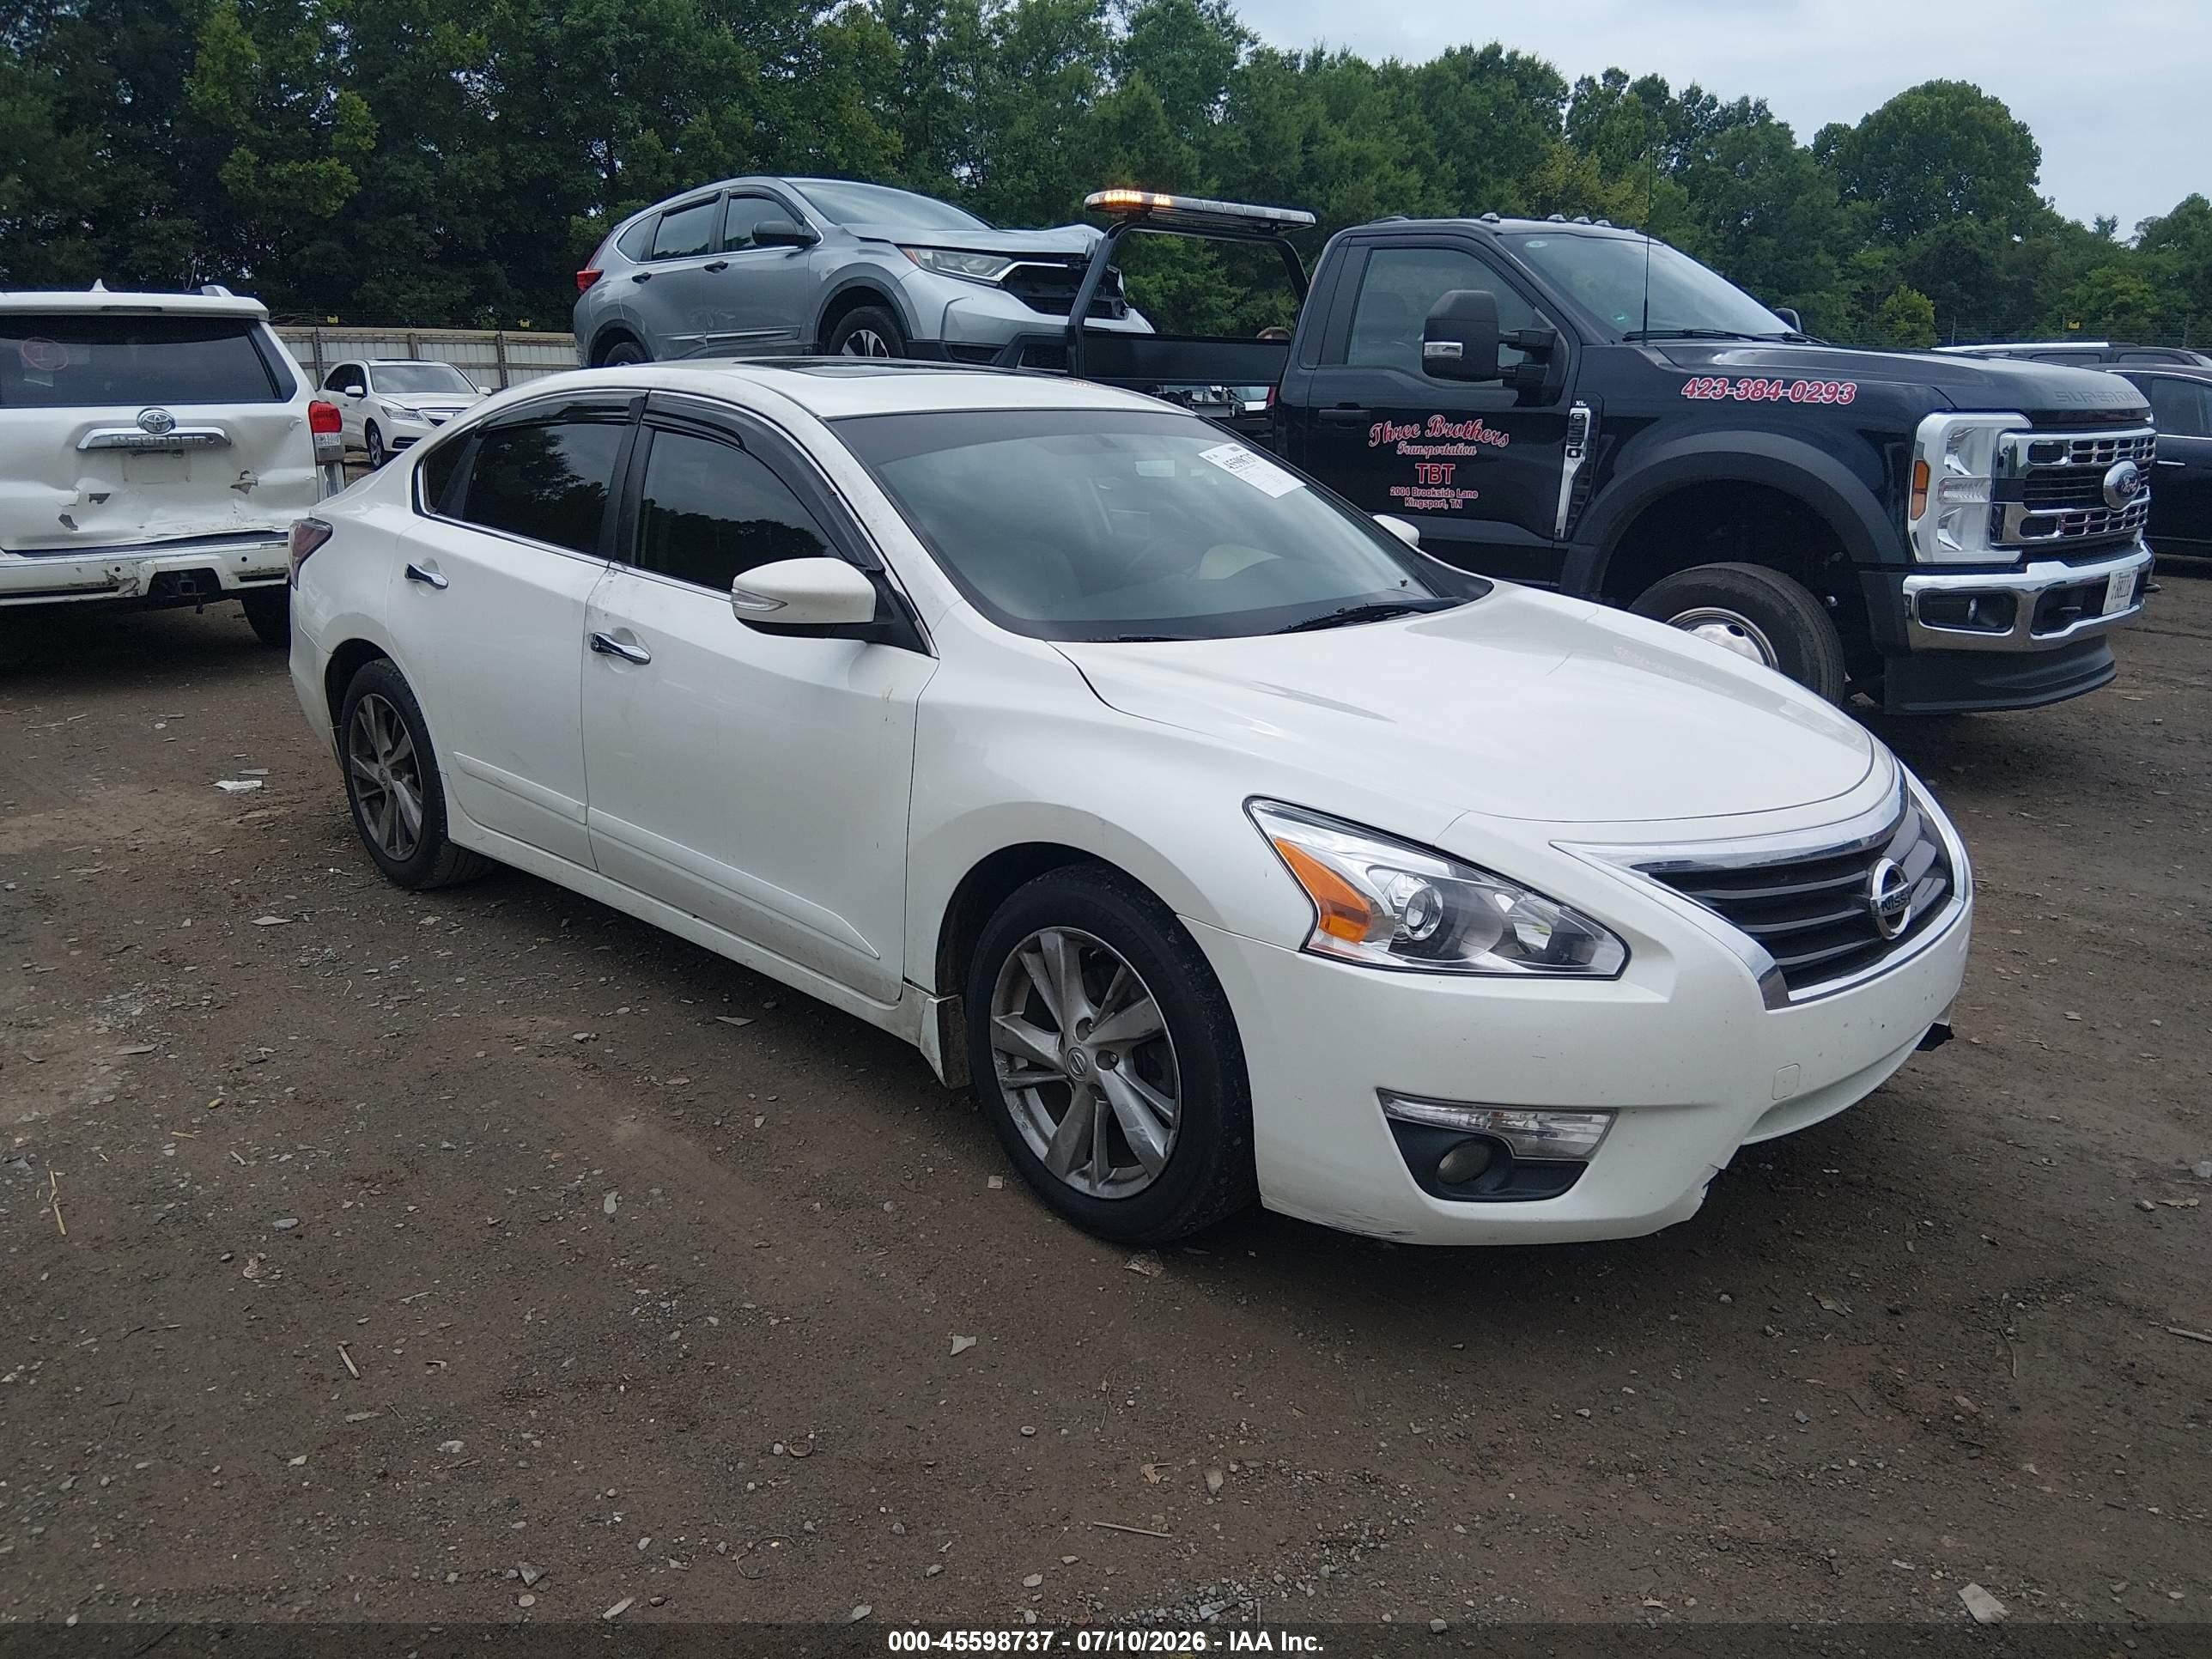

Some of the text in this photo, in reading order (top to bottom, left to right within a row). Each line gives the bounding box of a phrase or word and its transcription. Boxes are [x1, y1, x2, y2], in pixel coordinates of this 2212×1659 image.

[1681, 378, 1857, 404] 423-384-0293
[1369, 415, 1509, 447] Three Brothers
[1396, 441, 1477, 459] Transportation
[1414, 463, 1455, 484] TBT
[1390, 487, 1479, 499] 2004 Brookside Lane
[1405, 497, 1463, 509] Kingsport, TN
